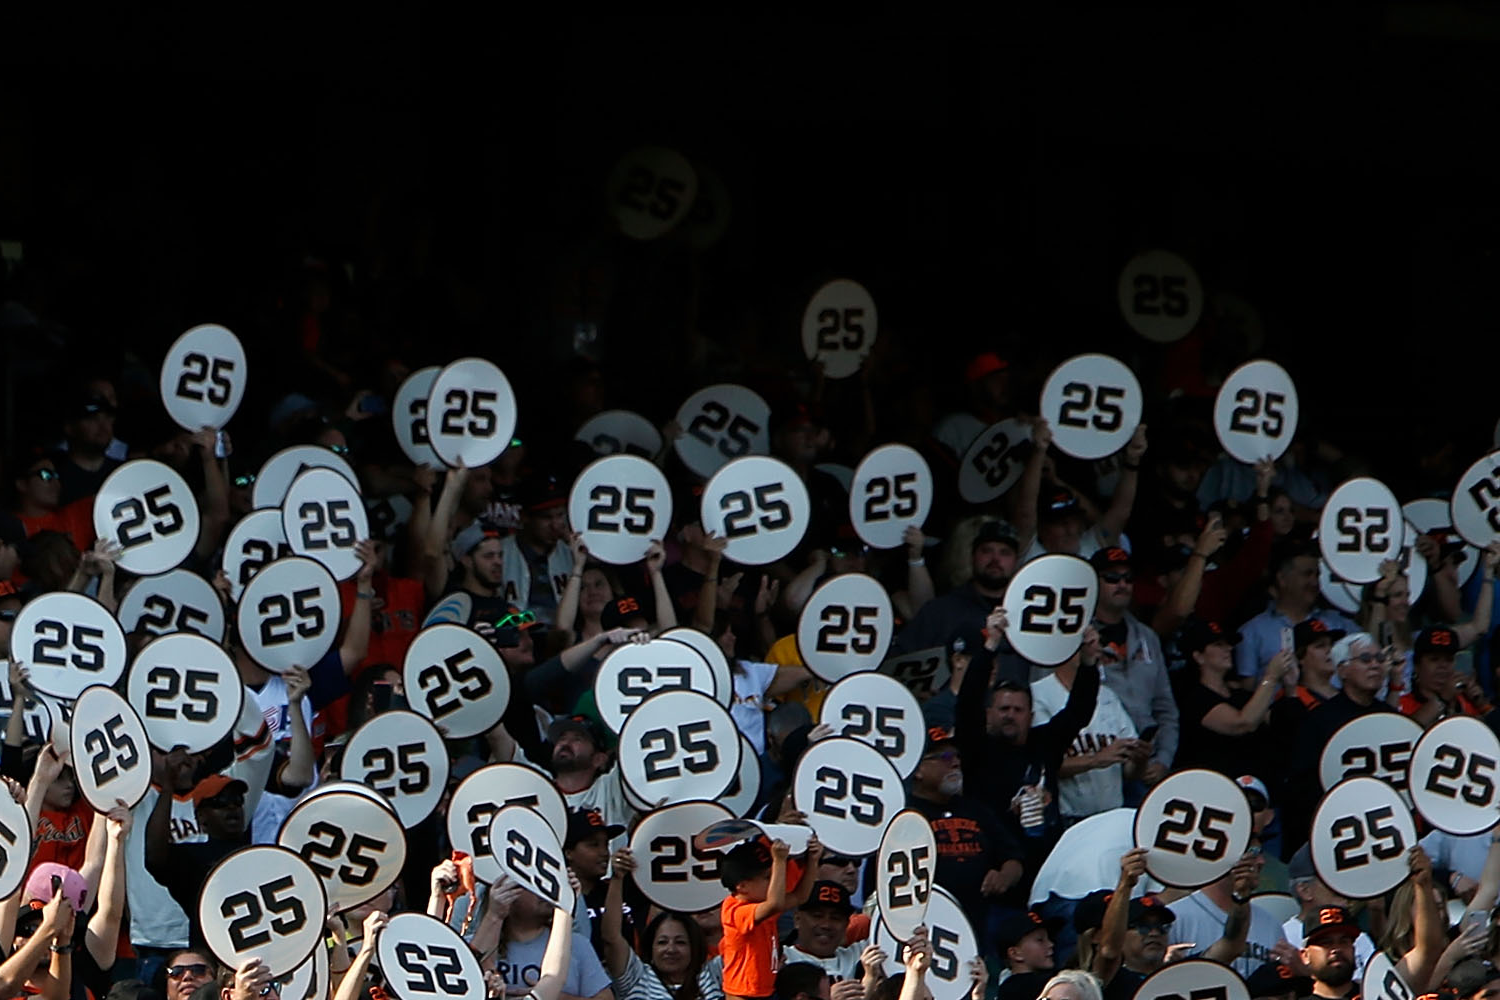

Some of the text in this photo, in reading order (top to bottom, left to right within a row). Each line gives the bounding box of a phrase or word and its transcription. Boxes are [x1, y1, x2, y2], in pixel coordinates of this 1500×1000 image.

[1132, 274, 1190, 318] 25
[817, 307, 866, 352] 25
[176, 354, 234, 405] 25
[441, 389, 498, 437] 25
[689, 401, 759, 459] 25
[1058, 382, 1124, 433] 25
[1230, 388, 1285, 438] 25
[111, 485, 184, 548] 25
[301, 500, 355, 549] 25
[588, 485, 656, 535] 25
[720, 482, 793, 538] 25
[865, 472, 918, 522] 25
[258, 588, 328, 647] 25
[817, 606, 878, 654] 25
[1020, 585, 1088, 635] 25
[33, 619, 105, 671] 25
[146, 667, 218, 722] 25
[417, 649, 493, 720] 25
[86, 715, 139, 788] 25
[641, 721, 718, 781] 25
[842, 705, 905, 757] 25
[363, 742, 430, 797] 25
[815, 766, 884, 826] 25
[1426, 743, 1496, 804] 25
[301, 820, 386, 886] 25
[1156, 799, 1234, 861] 25
[1331, 806, 1403, 870] 25
[506, 830, 560, 901] 25
[887, 847, 930, 908] 25
[221, 875, 308, 952] 25
[820, 886, 842, 904] 25
[1321, 907, 1345, 925] 25
